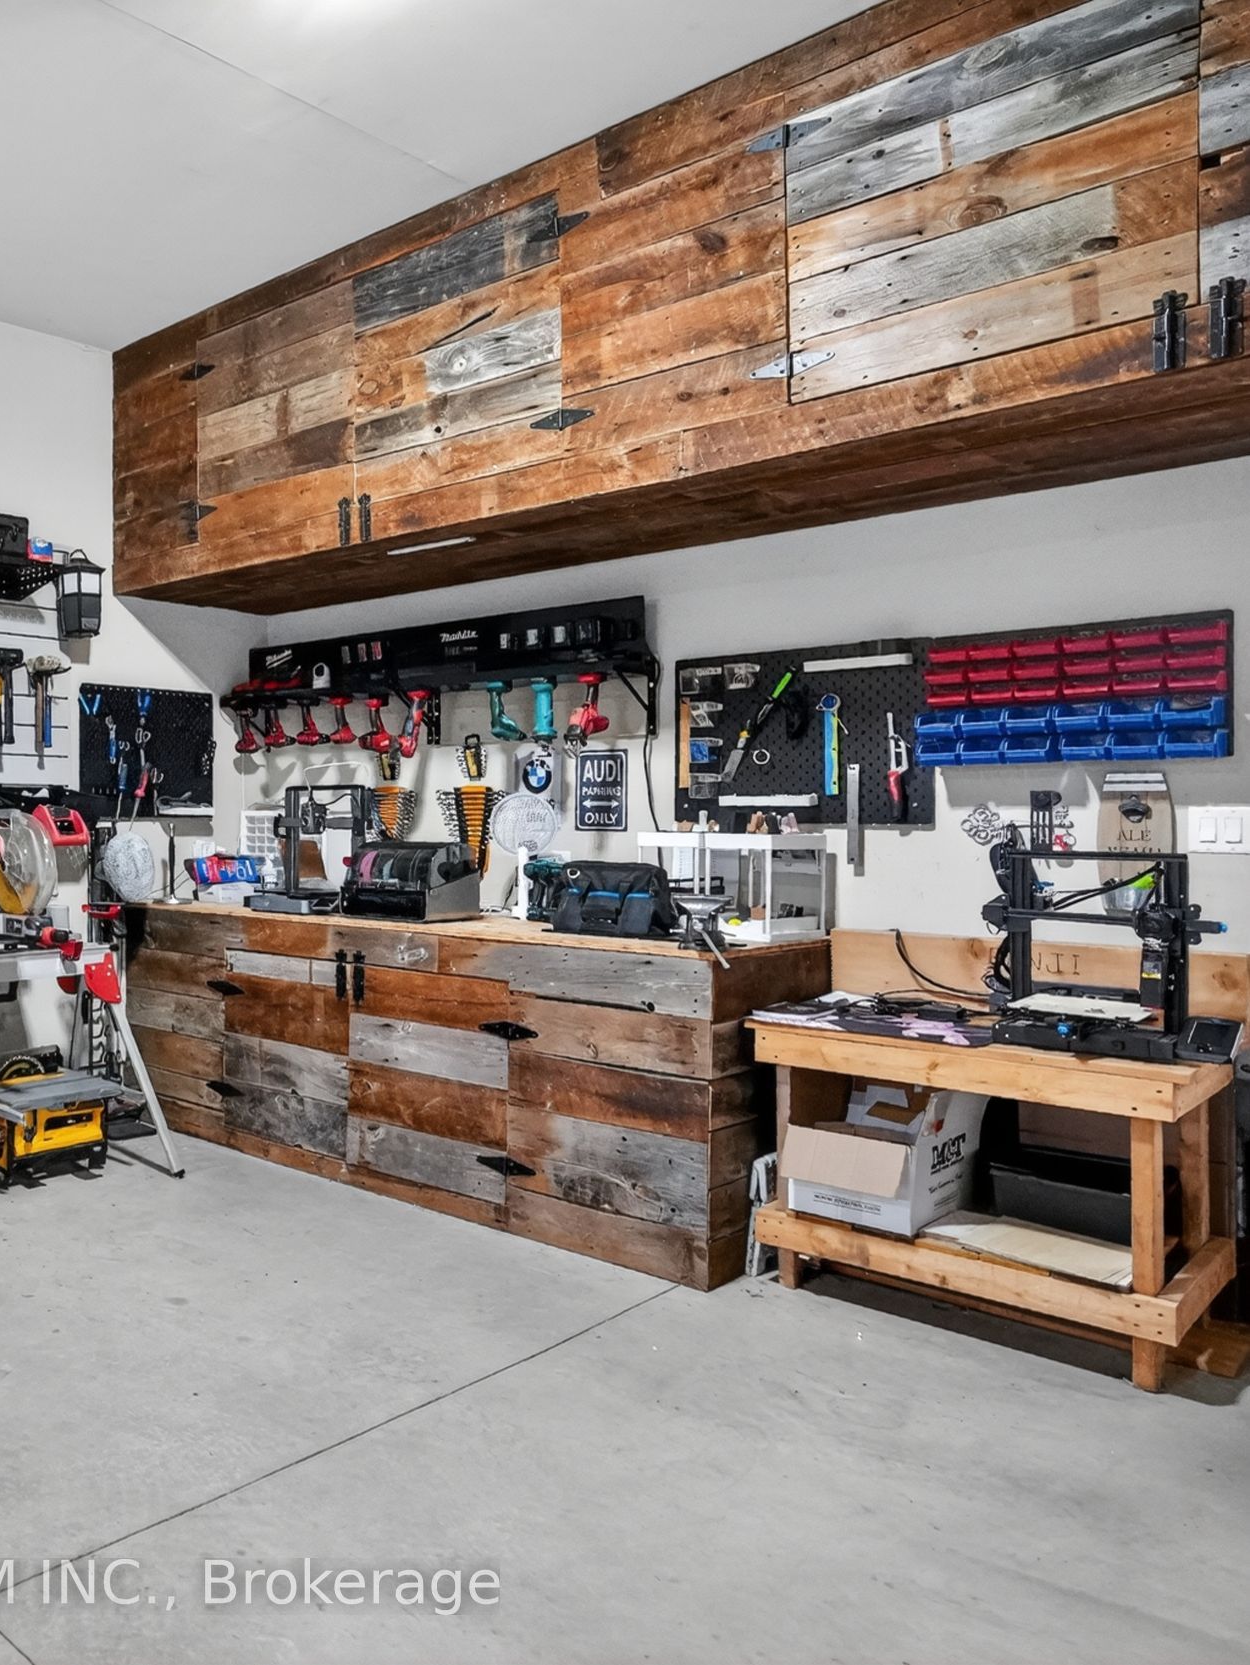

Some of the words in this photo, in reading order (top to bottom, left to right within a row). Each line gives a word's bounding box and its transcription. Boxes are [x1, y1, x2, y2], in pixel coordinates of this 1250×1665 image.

[583, 759, 621, 782] AUDI
[582, 786, 621, 796] PARKING
[585, 812, 618, 824] ONLY
[1117, 830, 1152, 841] ALE
